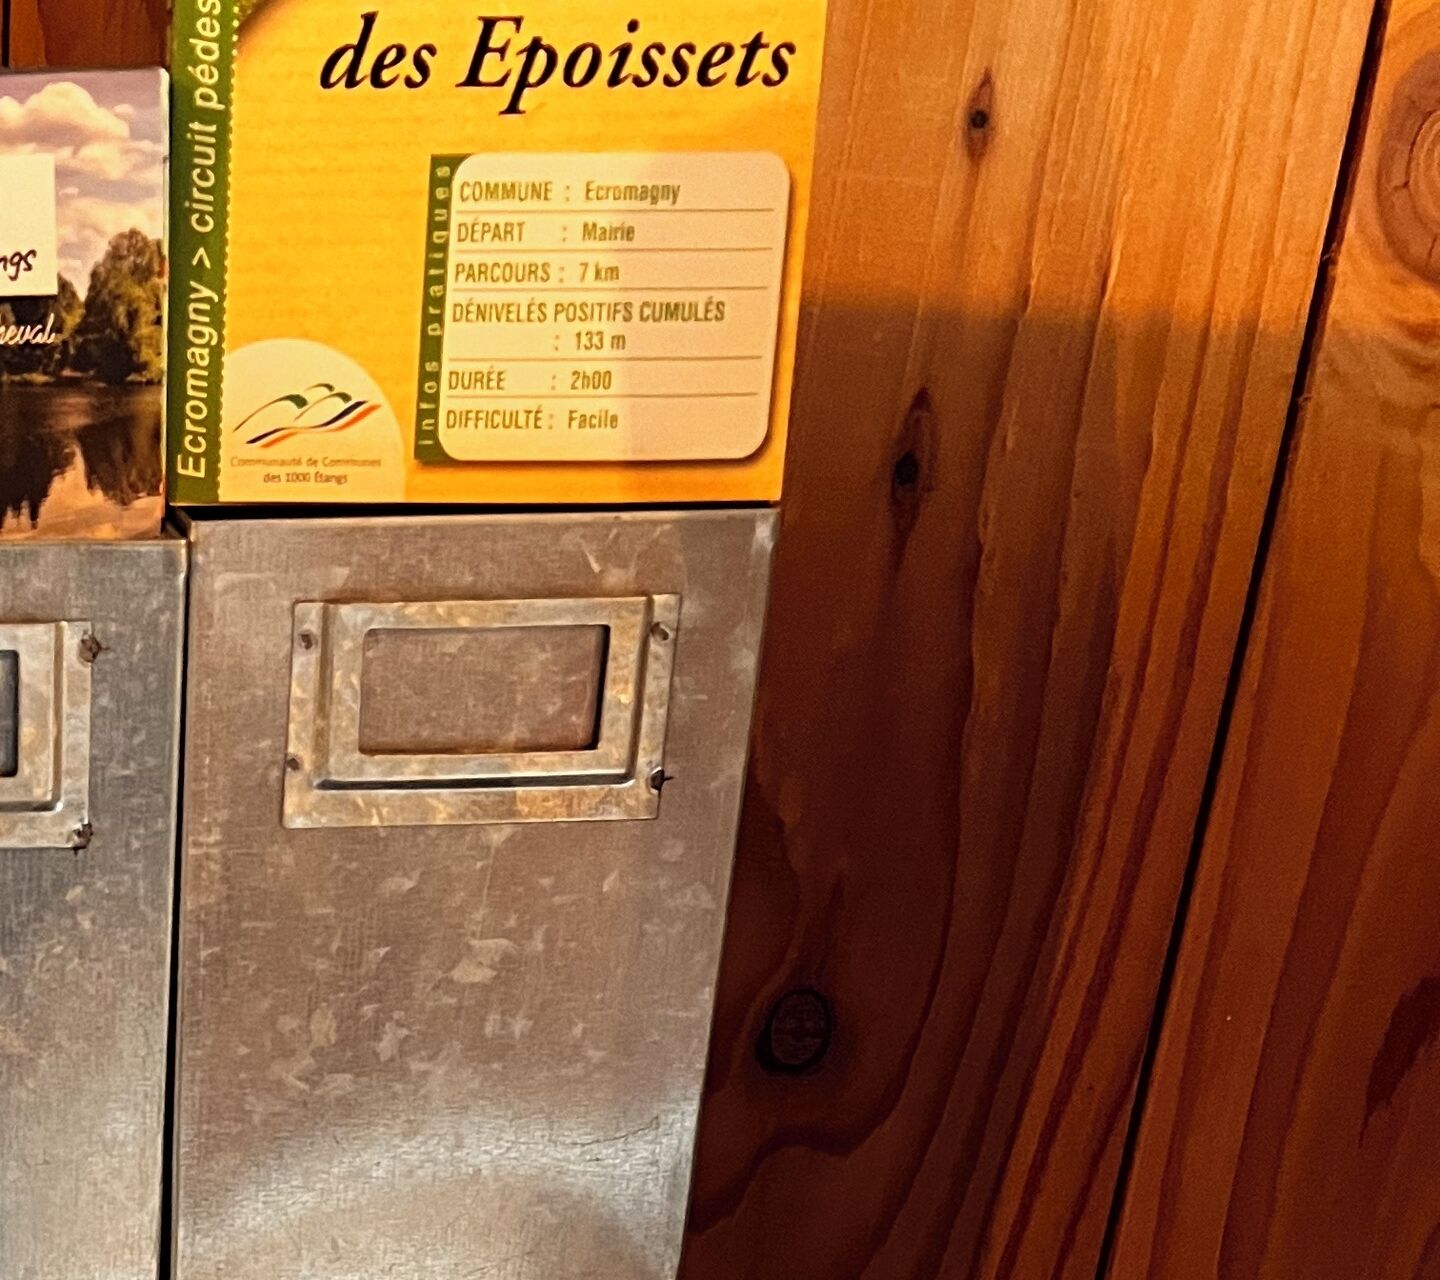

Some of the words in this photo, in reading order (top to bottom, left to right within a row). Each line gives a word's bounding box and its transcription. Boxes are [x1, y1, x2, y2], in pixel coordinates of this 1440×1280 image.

[320, 12, 436, 89] des
[454, 15, 796, 115] Epoissets
[191, 120, 217, 234] circuit
[459, 182, 553, 202] COMMUNE
[584, 182, 680, 206] Ecromagny
[457, 220, 526, 242] DÉPART
[582, 222, 634, 242] Mairie
[428, 166, 450, 336] pratiques
[455, 262, 550, 282] PARCOURS
[580, 262, 589, 281] 7
[594, 262, 620, 282] km
[452, 297, 548, 321] DÉNIVELÉS
[553, 302, 633, 321] POSITIFS
[639, 296, 725, 320] CUMULÉS
[574, 331, 605, 350] 133
[610, 335, 626, 350] m
[176, 279, 220, 479] Ecromagny
[447, 367, 505, 390] DURÉE
[571, 371, 611, 390] 2h00
[418, 361, 439, 445] infos
[446, 407, 543, 430] DIFFICULTÉ
[568, 410, 618, 429] Facile
